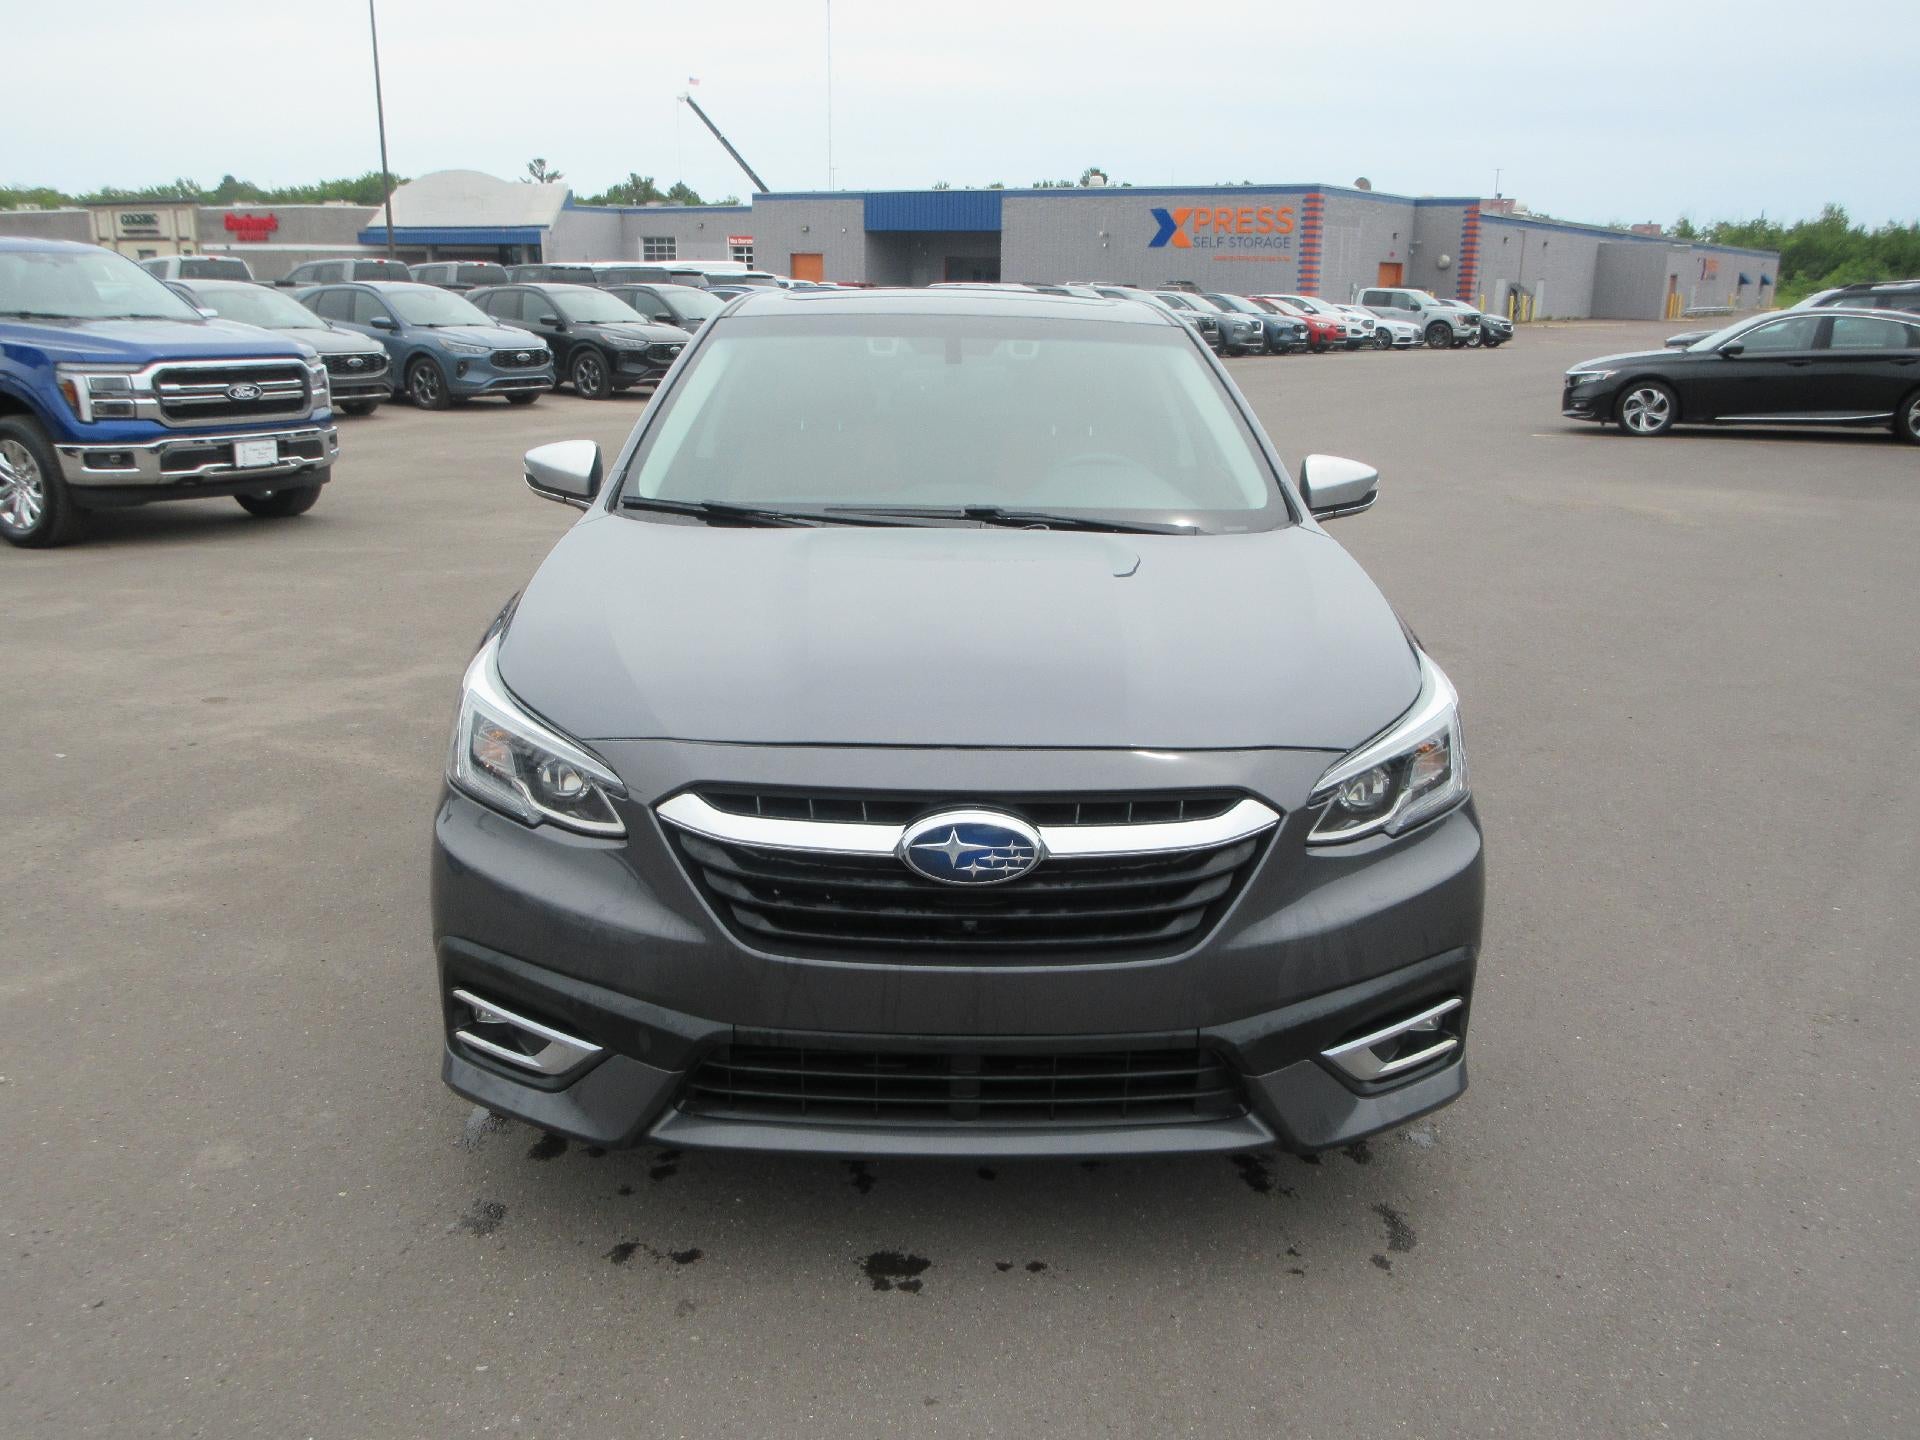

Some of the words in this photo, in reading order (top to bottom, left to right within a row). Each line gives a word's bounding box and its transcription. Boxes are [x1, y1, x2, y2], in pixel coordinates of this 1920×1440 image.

[1149, 207, 1295, 249] XPRESS
[1193, 236, 1225, 249] SELF
[1228, 236, 1292, 249] STORAGE
